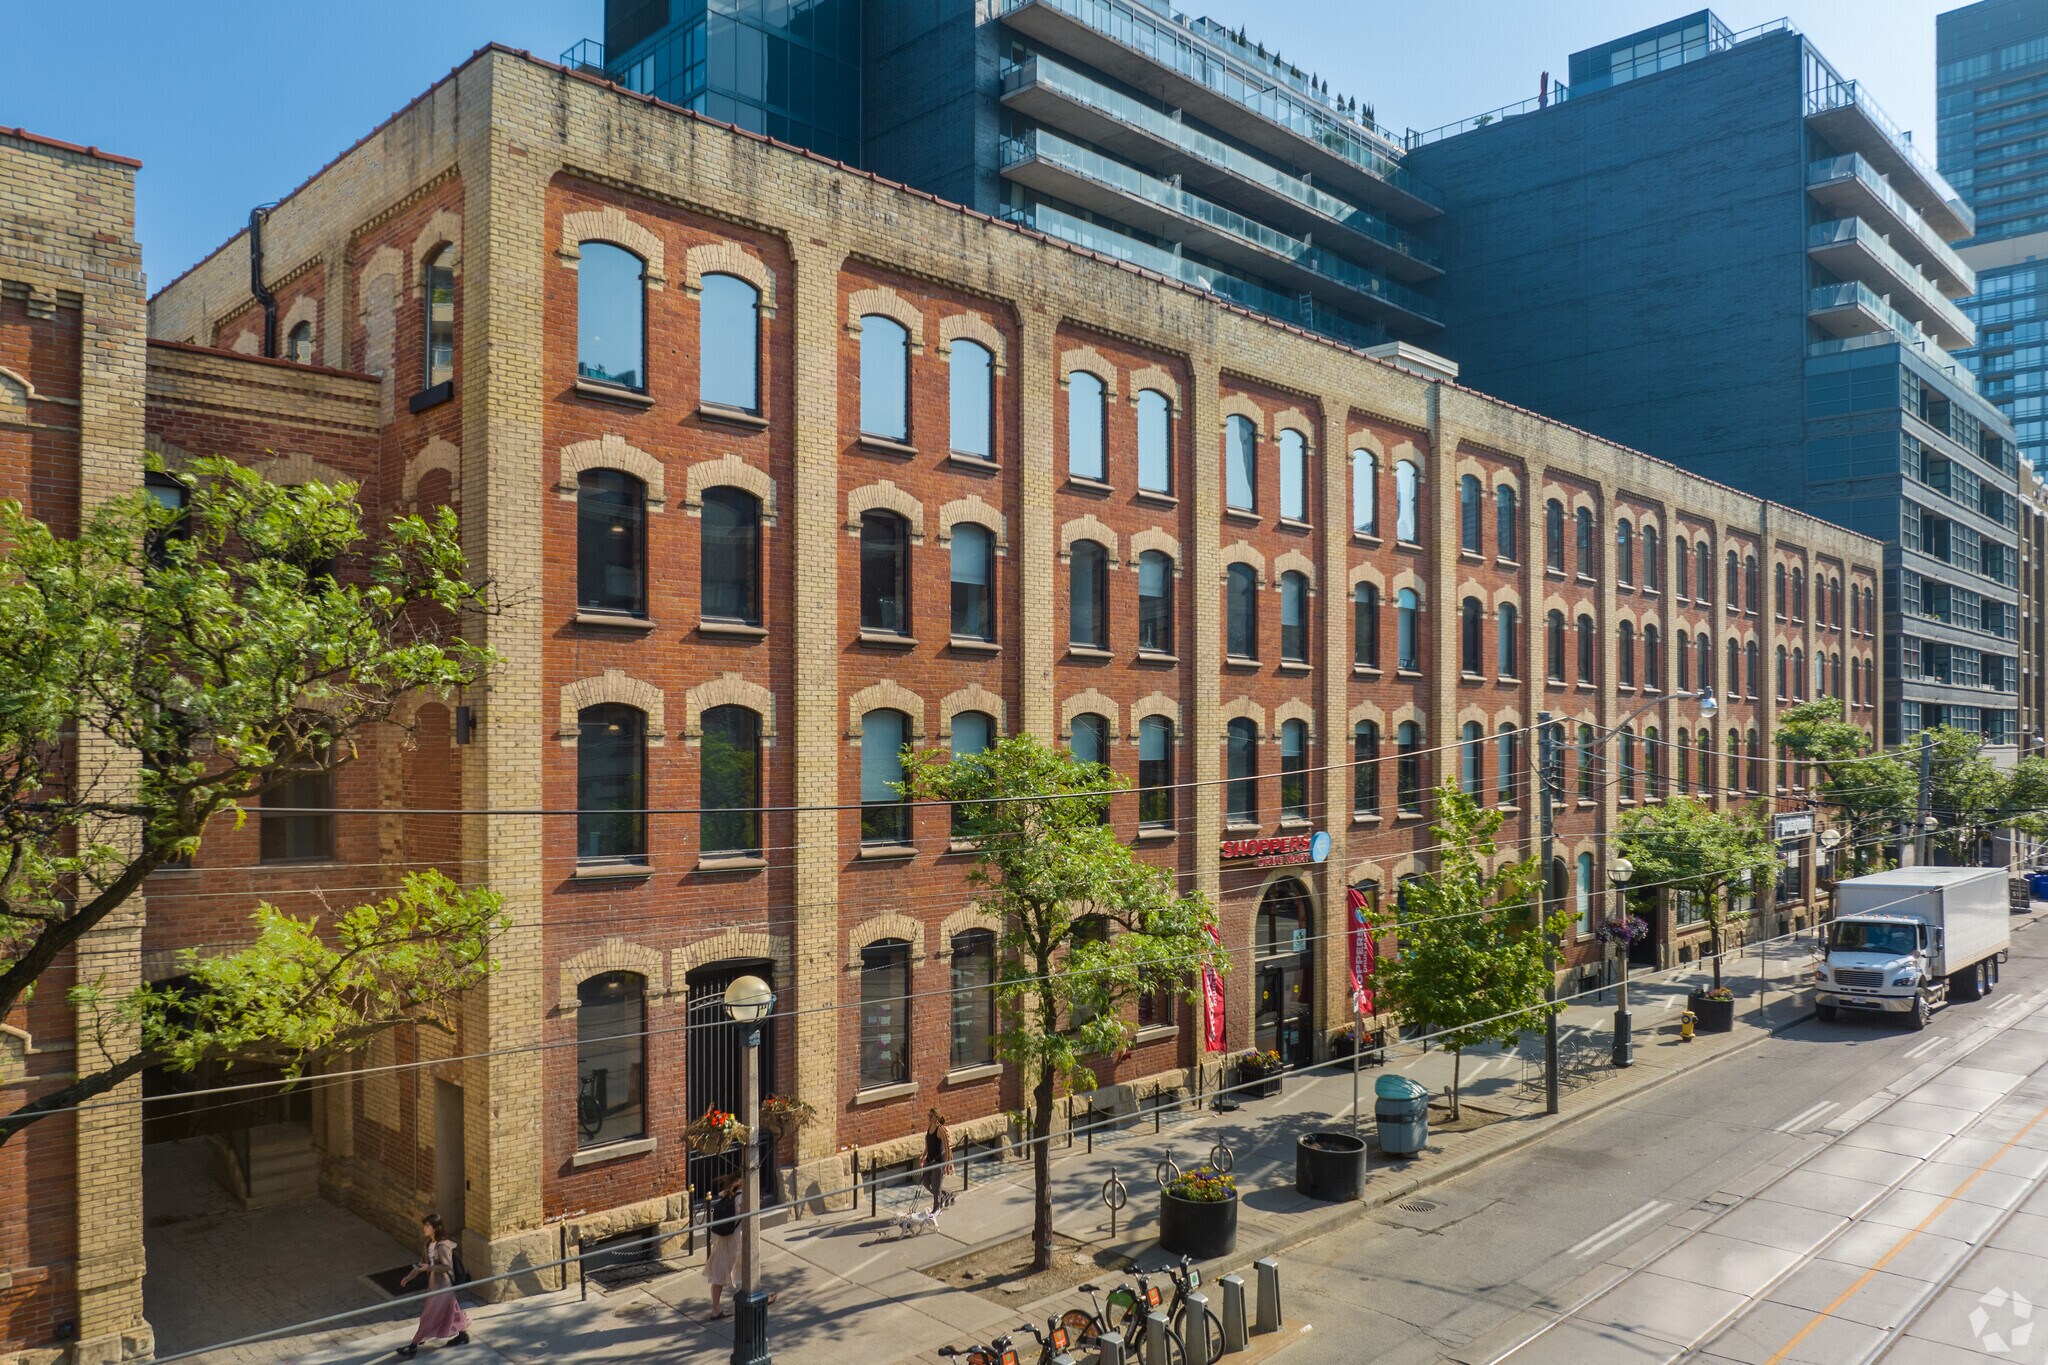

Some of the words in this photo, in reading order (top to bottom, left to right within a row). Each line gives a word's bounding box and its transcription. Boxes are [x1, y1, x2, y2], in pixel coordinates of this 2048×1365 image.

[1222, 836, 1310, 858] SHOPPERS
[1258, 854, 1284, 867] DRUG
[1285, 852, 1310, 865] MART
